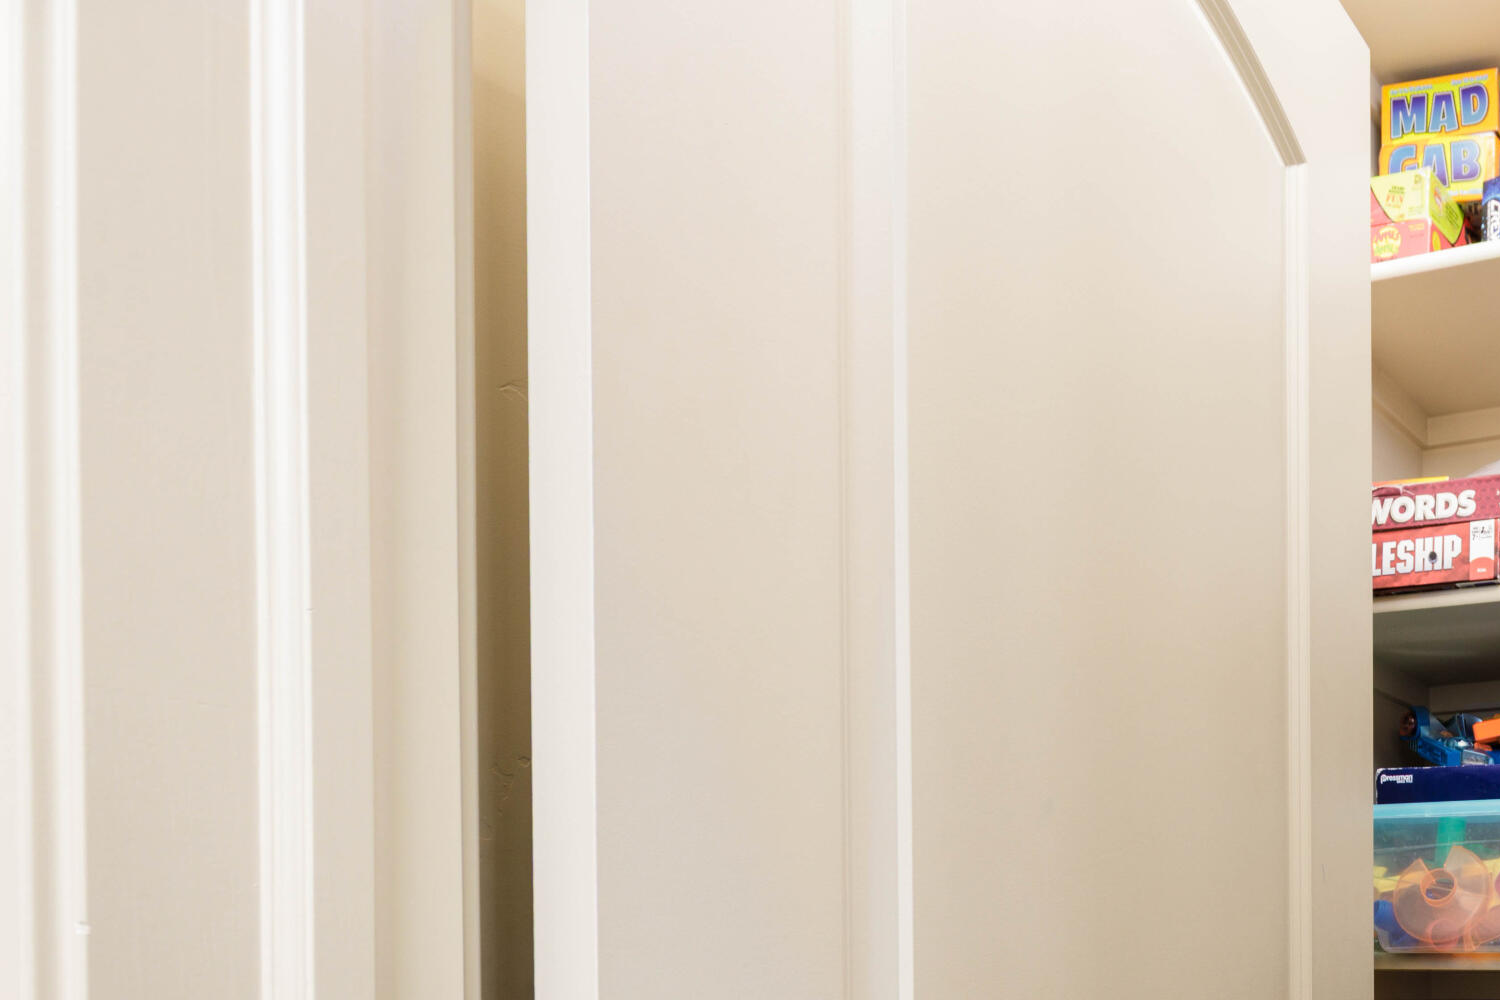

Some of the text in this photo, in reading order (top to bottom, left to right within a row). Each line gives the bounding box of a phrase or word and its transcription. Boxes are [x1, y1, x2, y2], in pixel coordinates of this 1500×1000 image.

[1390, 83, 1489, 139] MAD
[1388, 140, 1481, 188] GAB
[1372, 489, 1476, 526] WORDS
